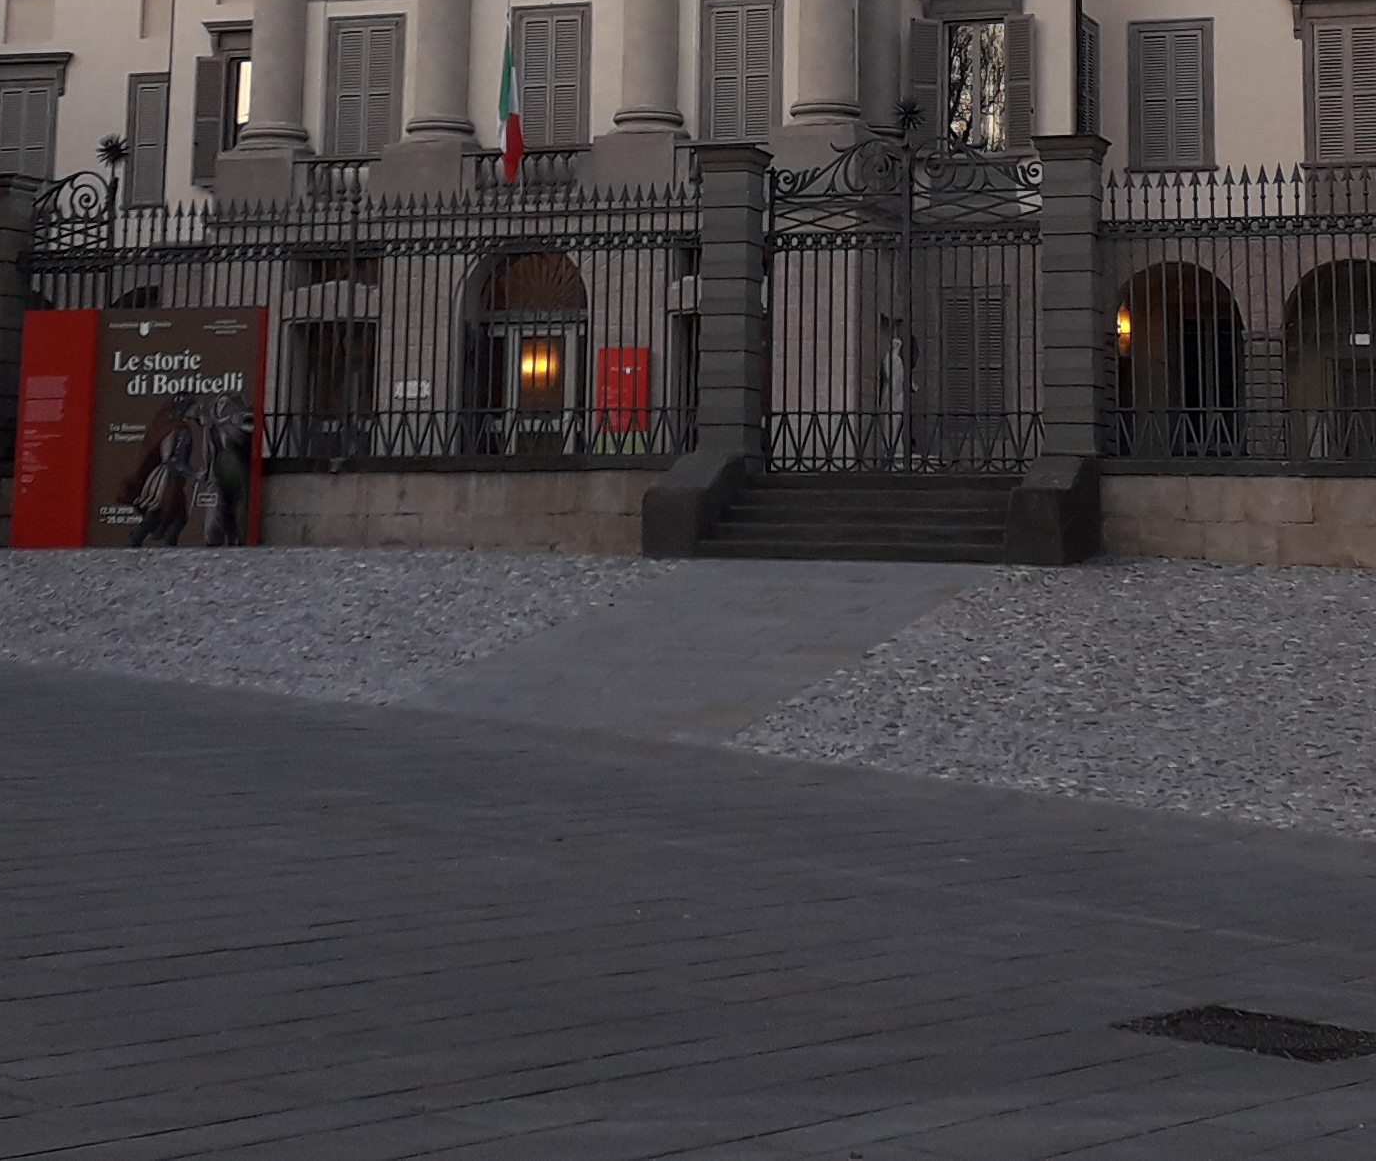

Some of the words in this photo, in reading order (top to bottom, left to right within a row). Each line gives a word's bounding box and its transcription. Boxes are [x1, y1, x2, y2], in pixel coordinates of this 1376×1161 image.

[113, 350, 139, 372] Le
[143, 349, 202, 370] storie
[126, 374, 147, 396] di
[152, 371, 245, 395] Botticelli
